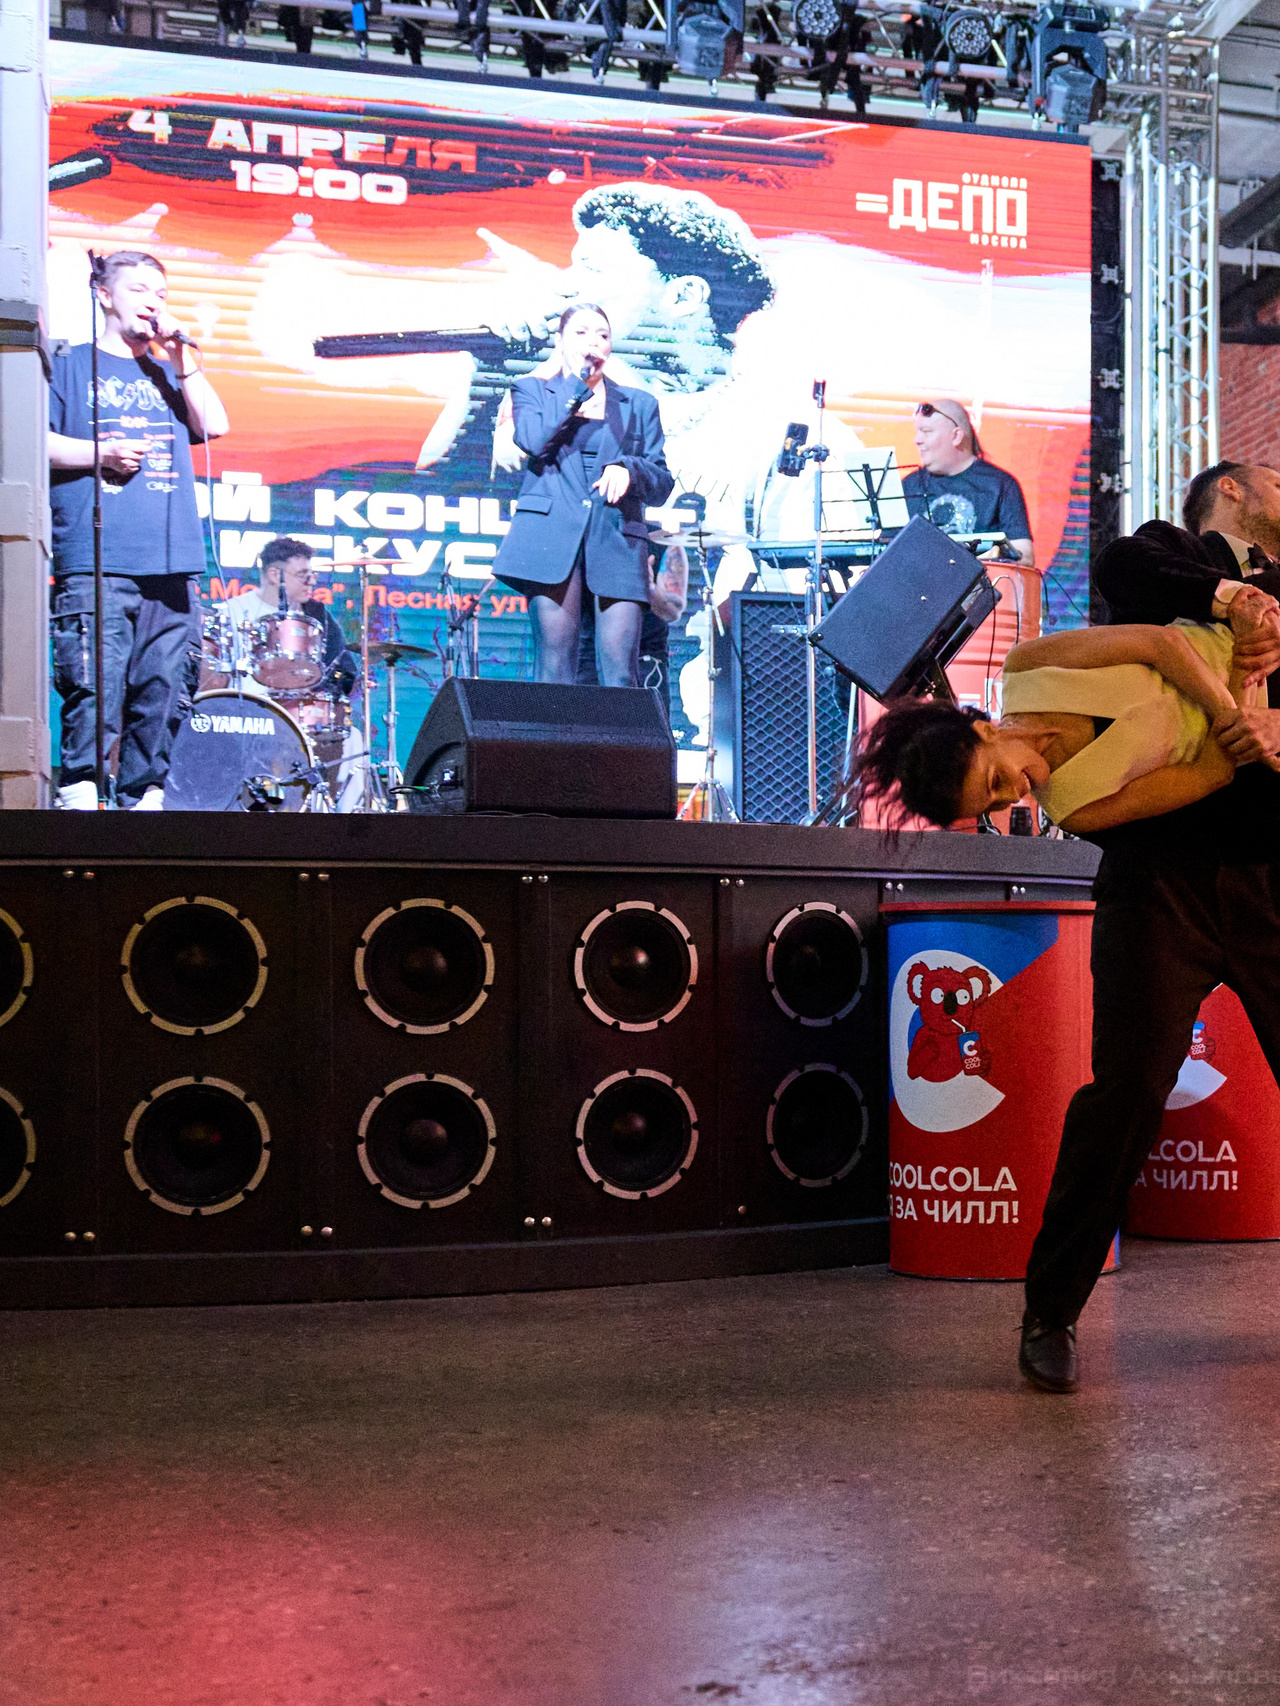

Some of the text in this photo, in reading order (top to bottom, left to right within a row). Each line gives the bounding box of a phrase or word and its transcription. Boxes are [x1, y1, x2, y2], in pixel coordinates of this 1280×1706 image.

[127, 109, 478, 174] 4 АПРЕЛЯ
[229, 159, 408, 206] 19:00
[888, 177, 1028, 237] ДЕПО
[969, 232, 1028, 250] МОСКВА
[210, 715, 276, 736] YAMAHA
[1152, 1168, 1239, 1191] ЧИЛЛ!
[922, 1198, 1020, 1225] ЧИЛЛ!
